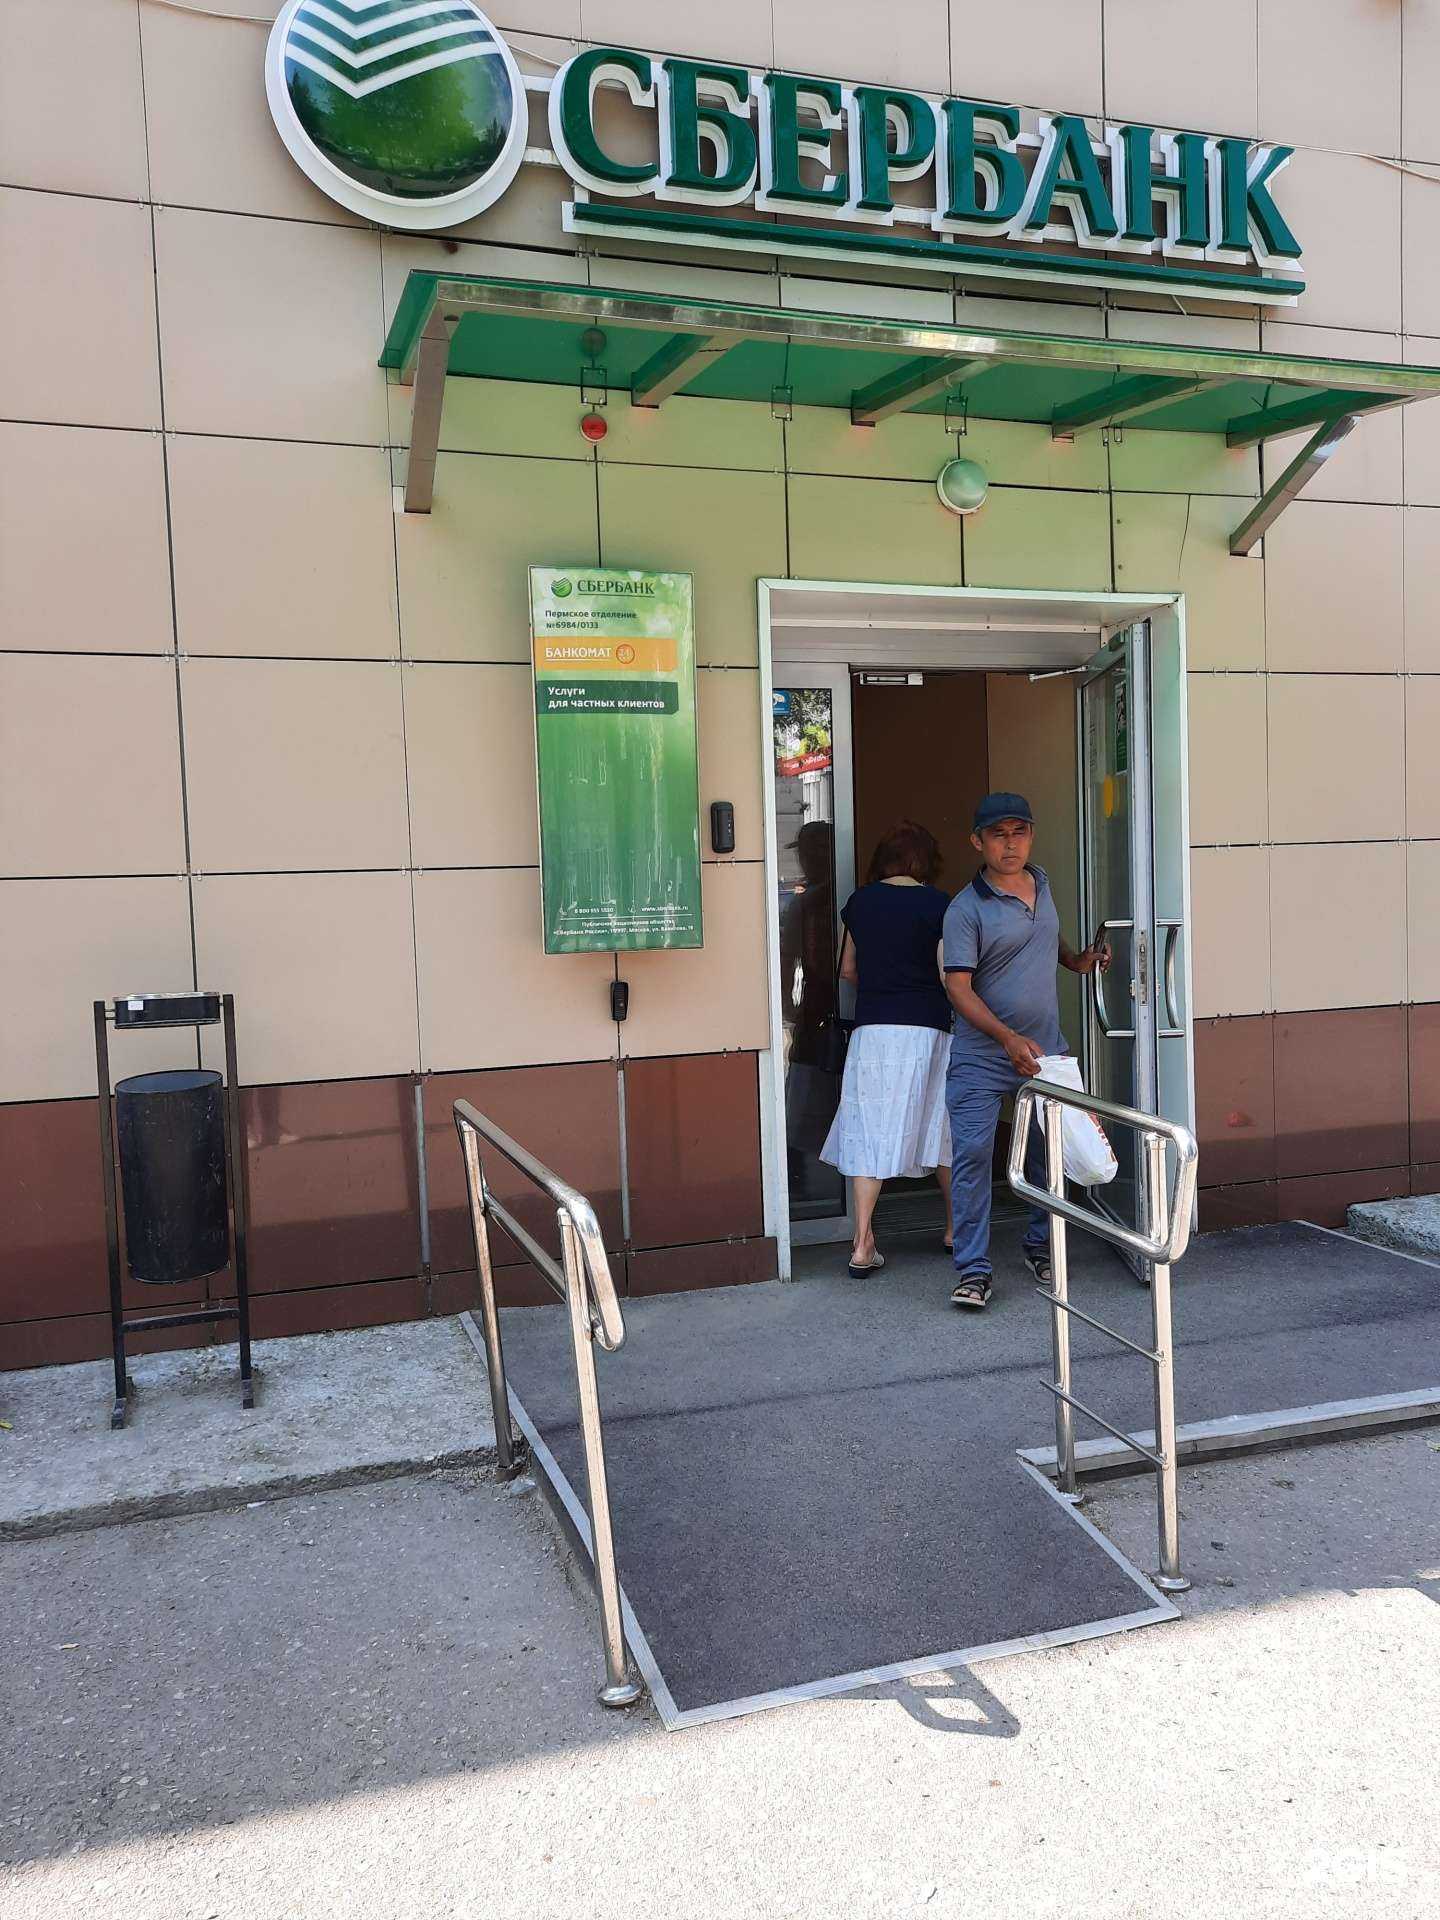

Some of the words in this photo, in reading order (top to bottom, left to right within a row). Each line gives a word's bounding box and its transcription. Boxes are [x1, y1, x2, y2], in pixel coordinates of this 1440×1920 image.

[550, 47, 1304, 269] СБЕРБАНК
[577, 579, 655, 595] СБЕРБАНК
[545, 610, 589, 620] Пермское
[591, 611, 637, 620] отделение
[545, 647, 612, 658] БАНКОМАТ
[548, 686, 586, 698] Услуги
[548, 700, 568, 709] для
[571, 700, 615, 708] частных
[618, 700, 665, 709] клиентов
